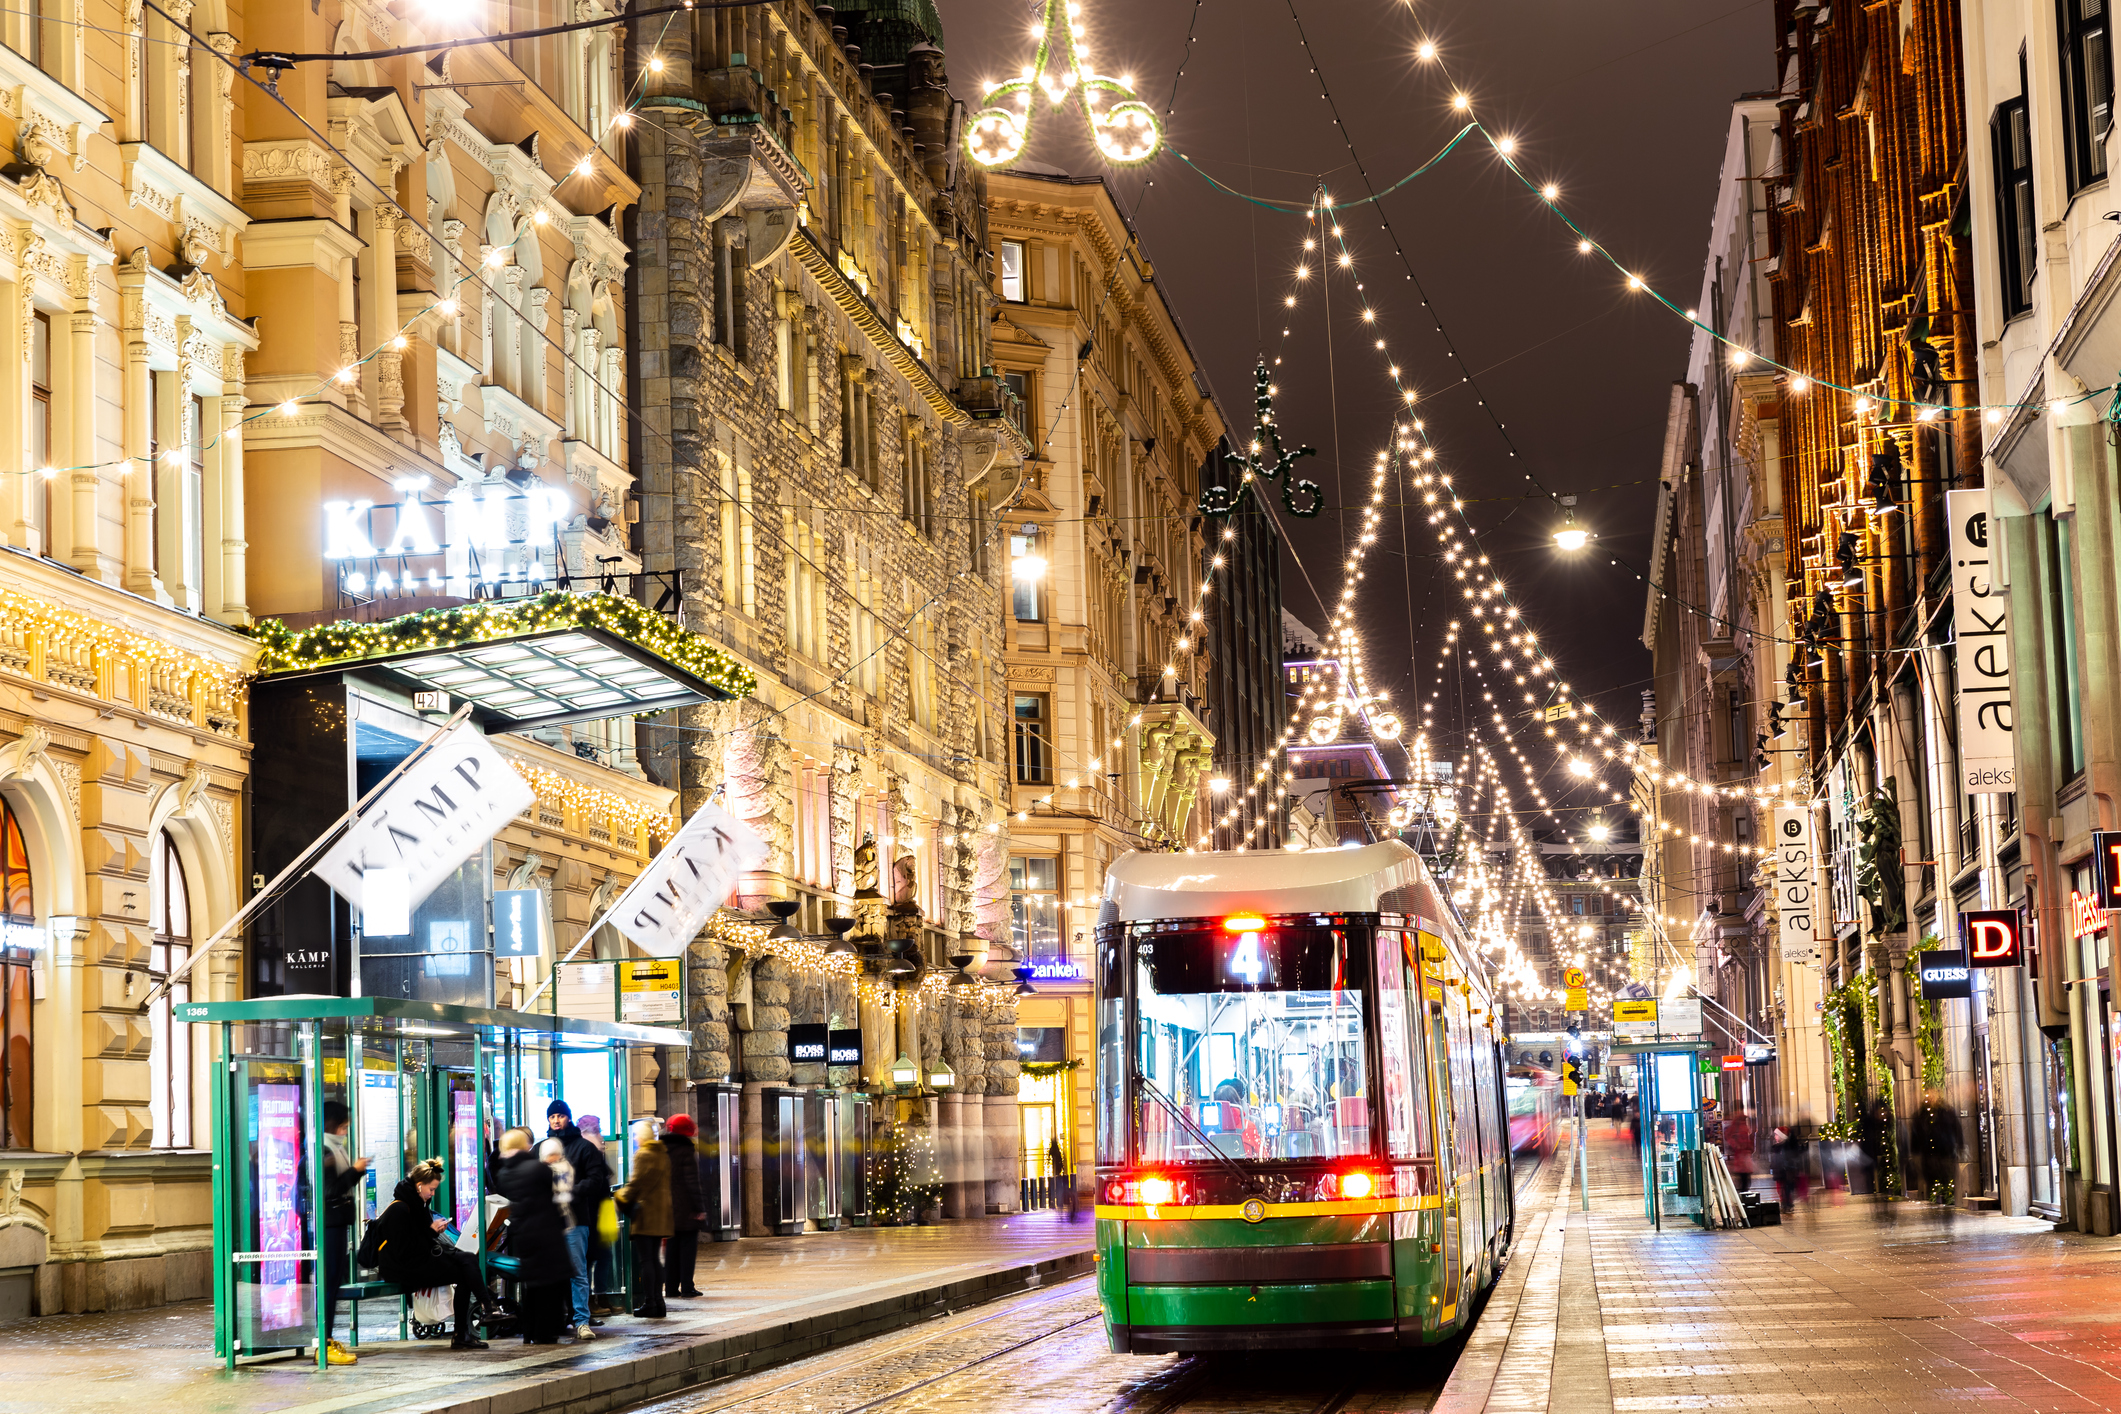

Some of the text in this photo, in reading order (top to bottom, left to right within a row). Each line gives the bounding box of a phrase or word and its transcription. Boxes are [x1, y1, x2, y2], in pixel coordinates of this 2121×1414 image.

[417, 693, 435, 709] 42
[1779, 842, 1811, 931] aleksi
[1137, 944, 1154, 954] 403
[1231, 931, 1262, 983] 4
[1784, 950, 1808, 959] aleksi
[557, 966, 562, 975] 5
[1022, 961, 1083, 978] banken
[1923, 967, 1968, 982] GUESS
[557, 976, 562, 984] 7
[186, 1007, 208, 1016] 1366
[795, 1045, 824, 1054] BOSS
[832, 1049, 858, 1058] BOSS
